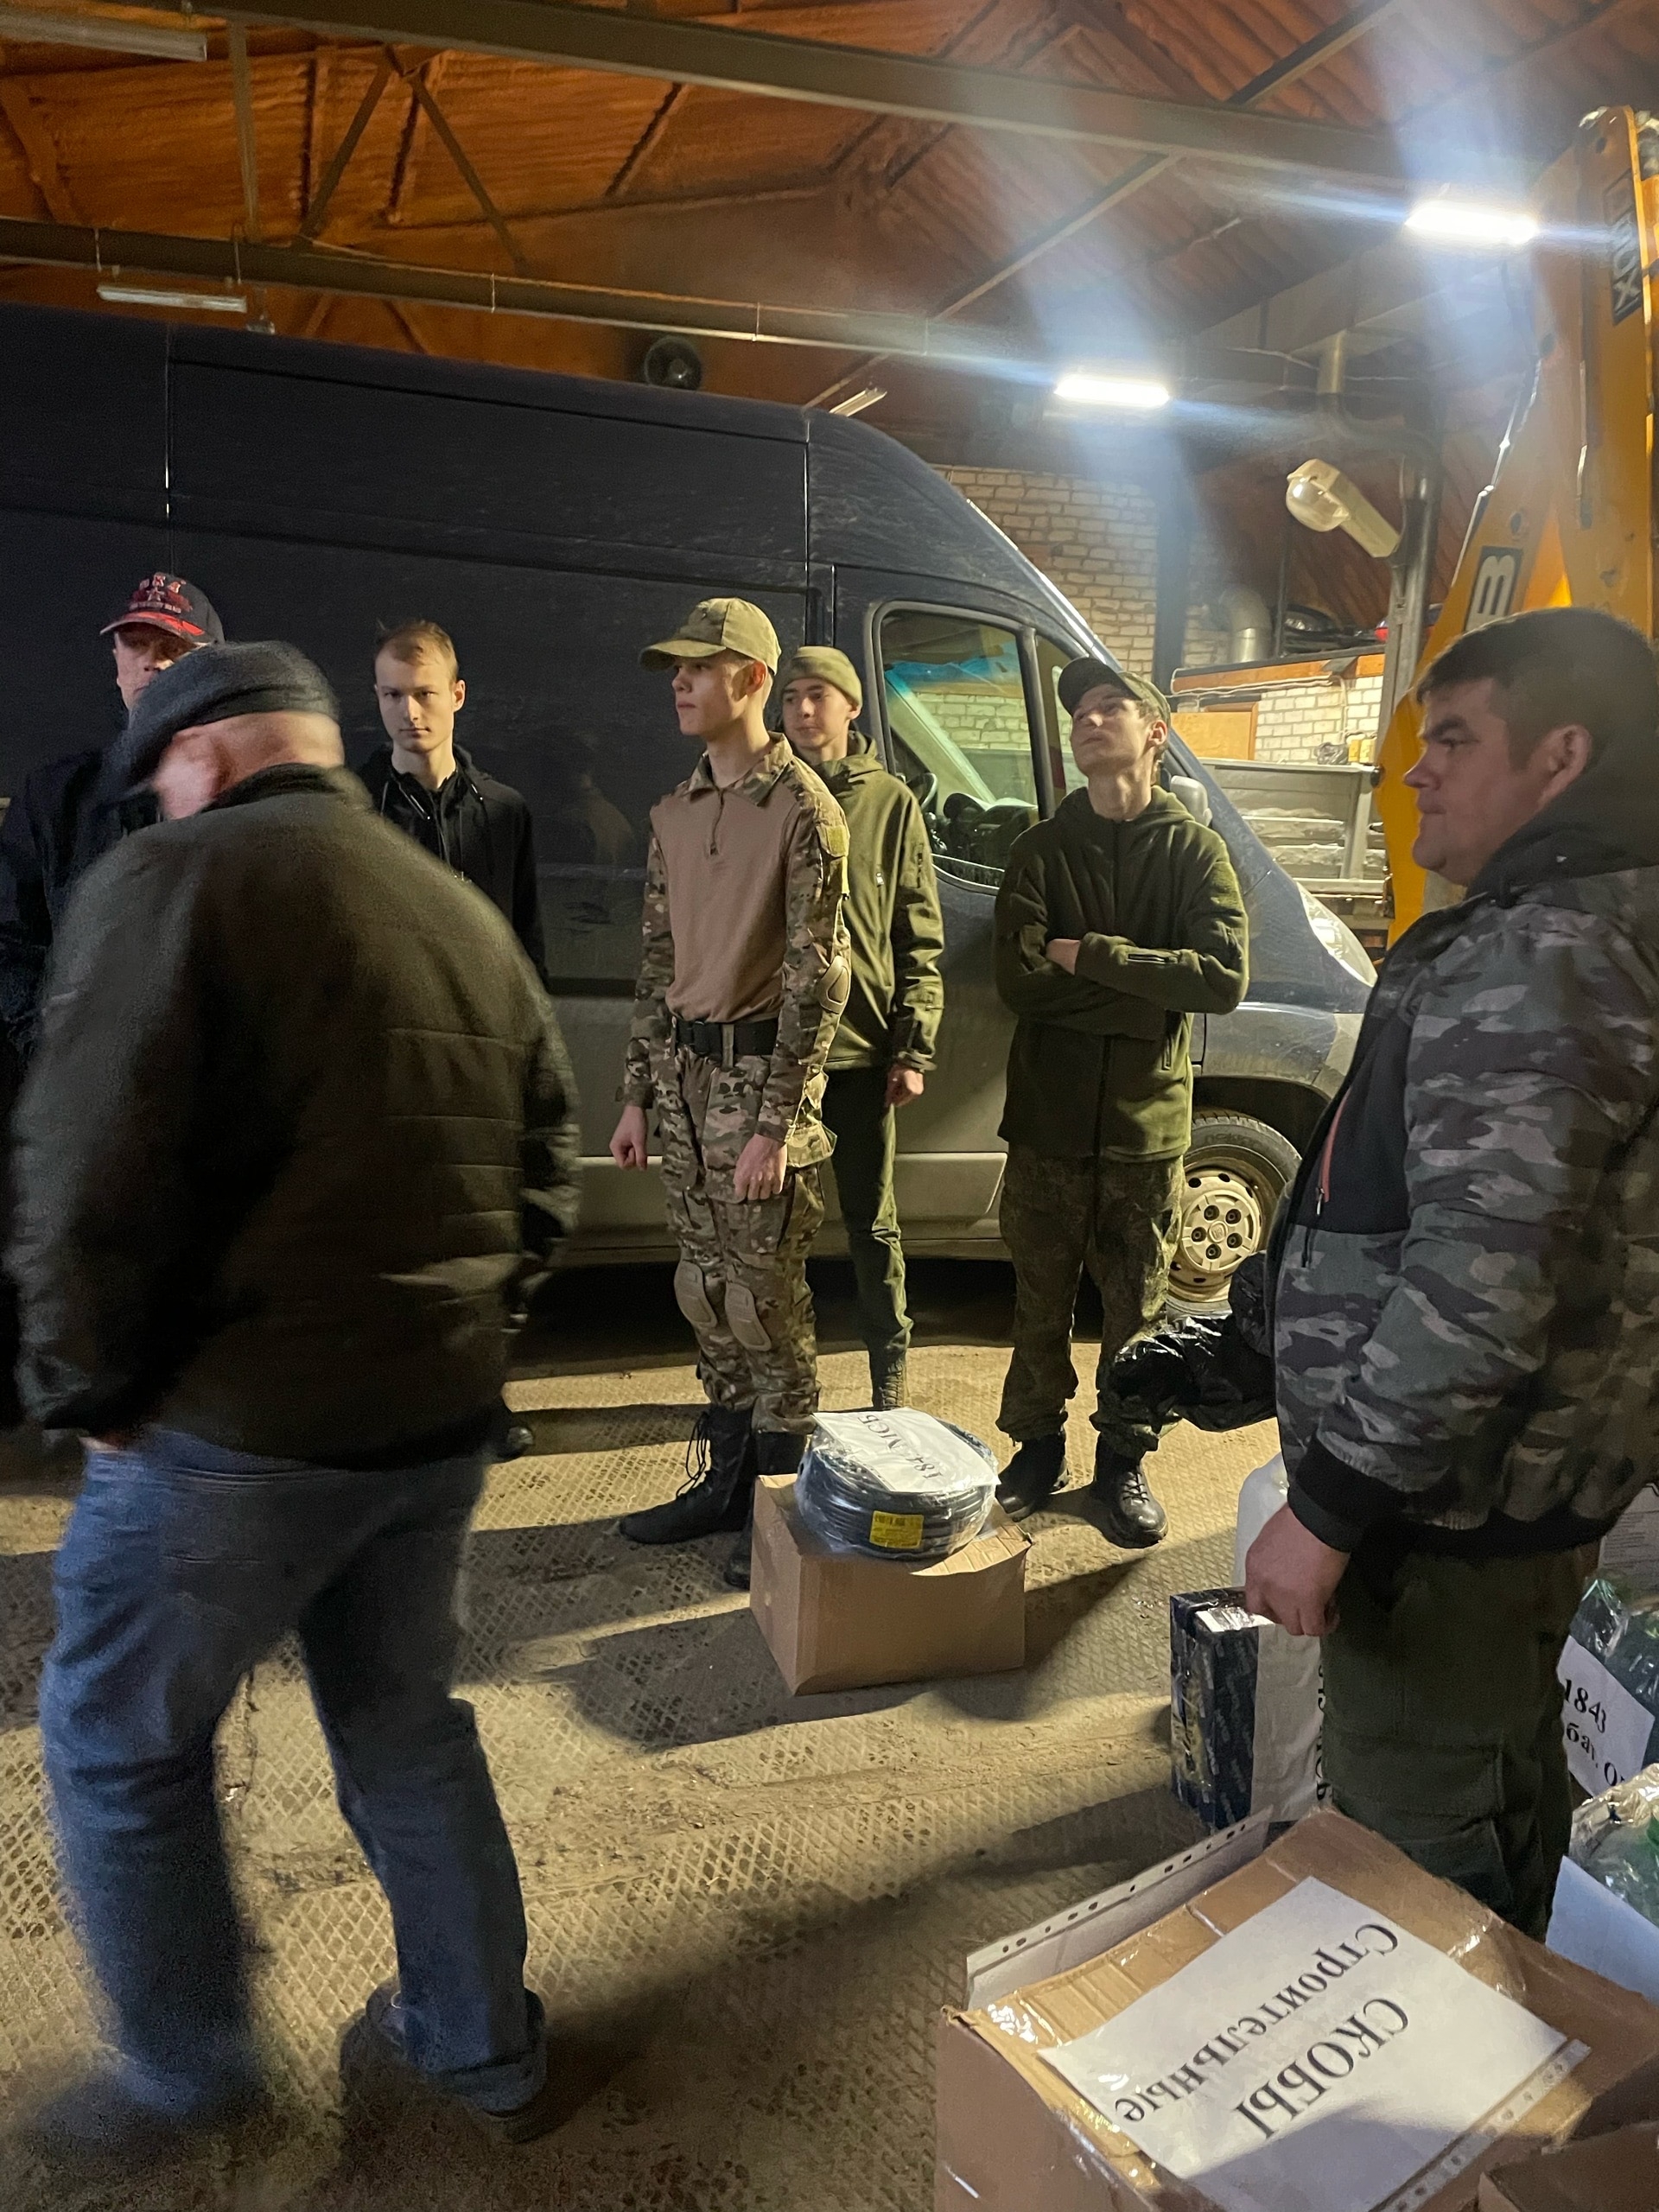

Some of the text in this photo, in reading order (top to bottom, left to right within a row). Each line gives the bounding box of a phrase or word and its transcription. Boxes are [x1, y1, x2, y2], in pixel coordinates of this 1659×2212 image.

[905, 1453, 944, 1478] 184
[1114, 1923, 1399, 2123] Строительные
[1235, 1998, 1409, 2140] СКОБЫ
